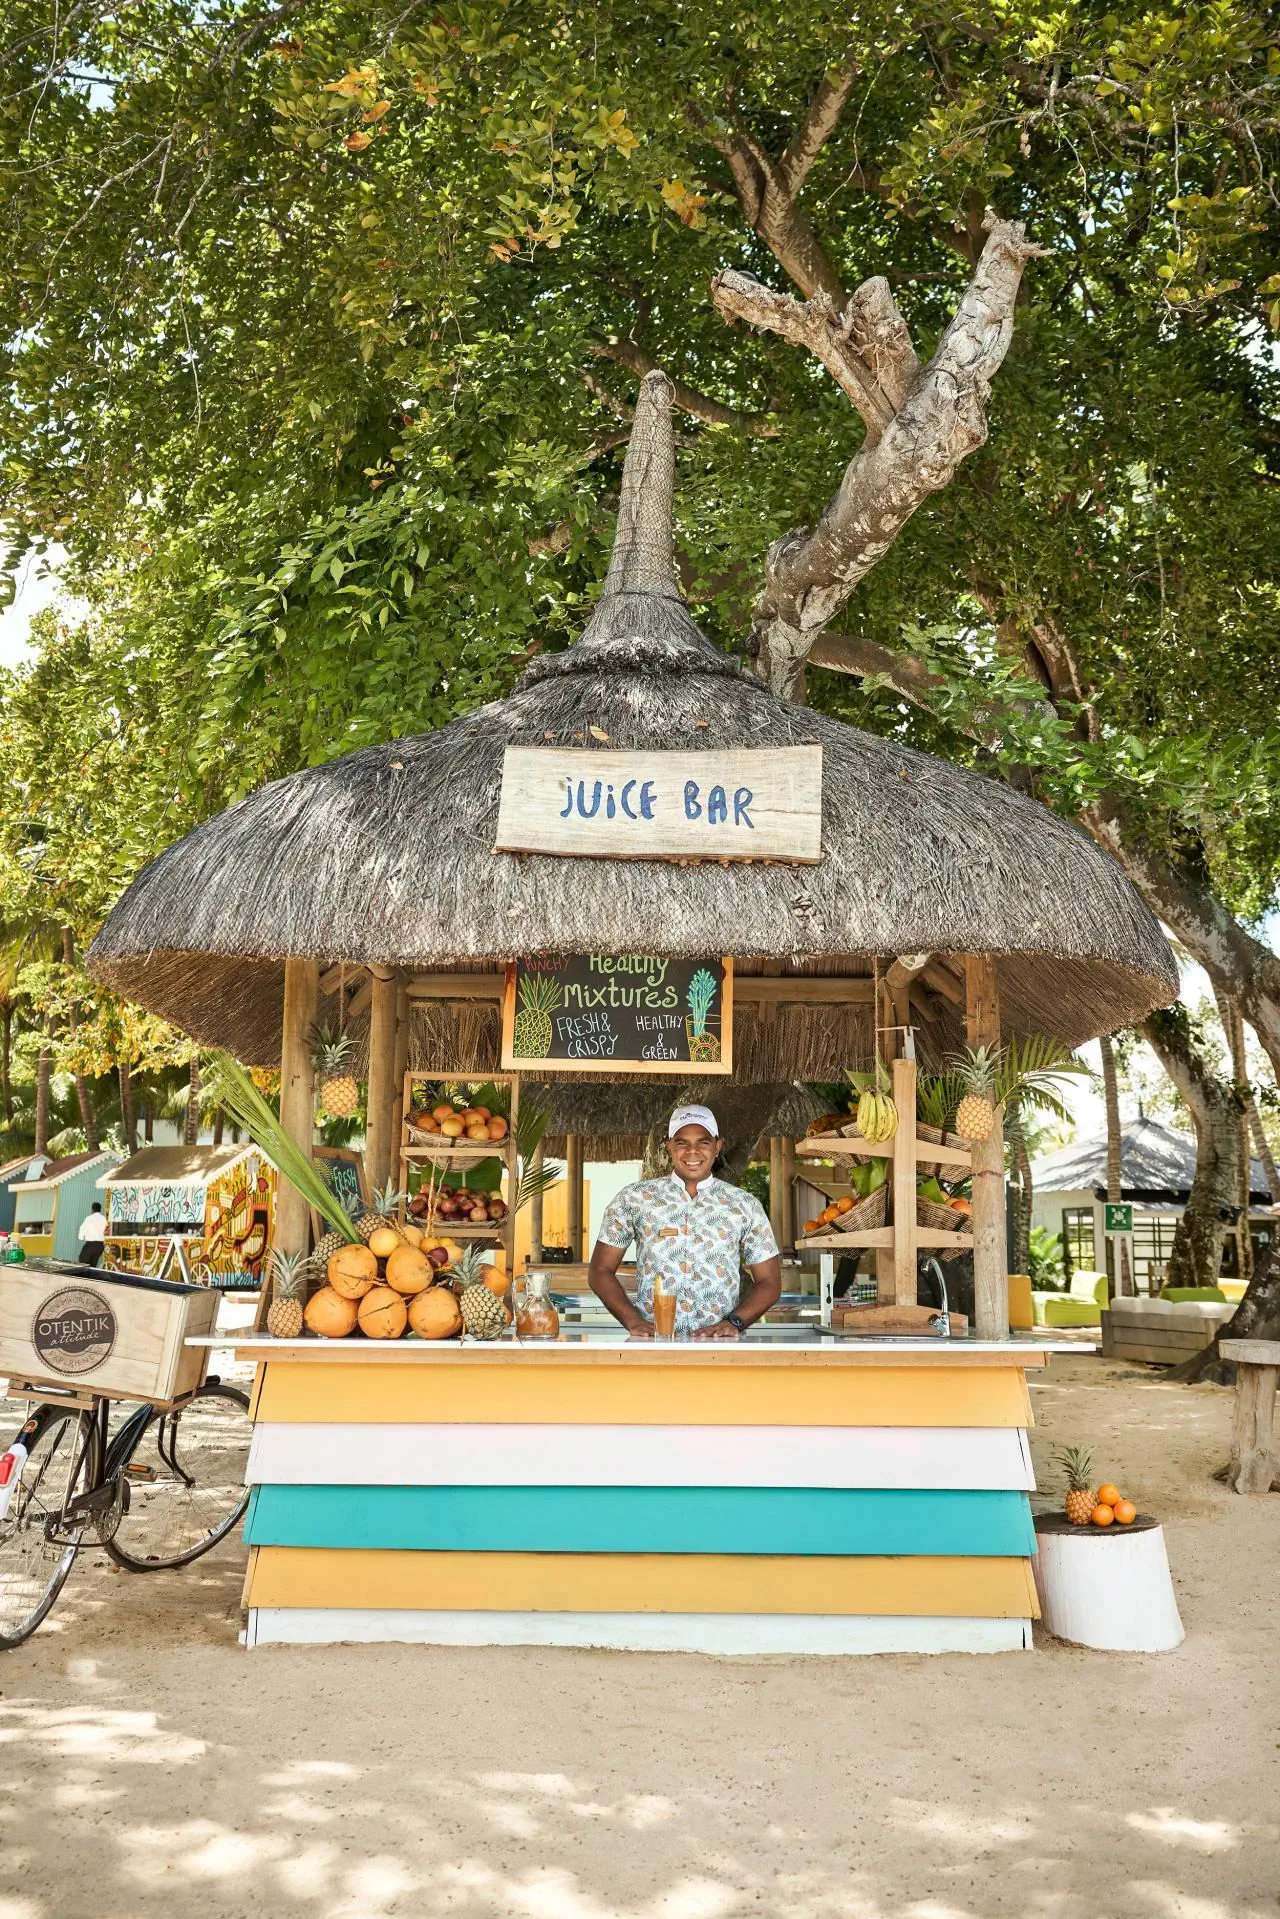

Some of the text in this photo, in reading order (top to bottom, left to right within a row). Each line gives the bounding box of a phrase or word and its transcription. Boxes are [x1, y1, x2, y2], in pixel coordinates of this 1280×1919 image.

[683, 779, 755, 829] BAR
[635, 1014, 684, 1031] HEALTHY
[656, 1032, 664, 1048] &
[641, 1044, 678, 1060] GREEN
[332, 1165, 358, 1193] FRESH
[39, 1316, 110, 1337] OTENTIK
[49, 1328, 101, 1346] attitude
